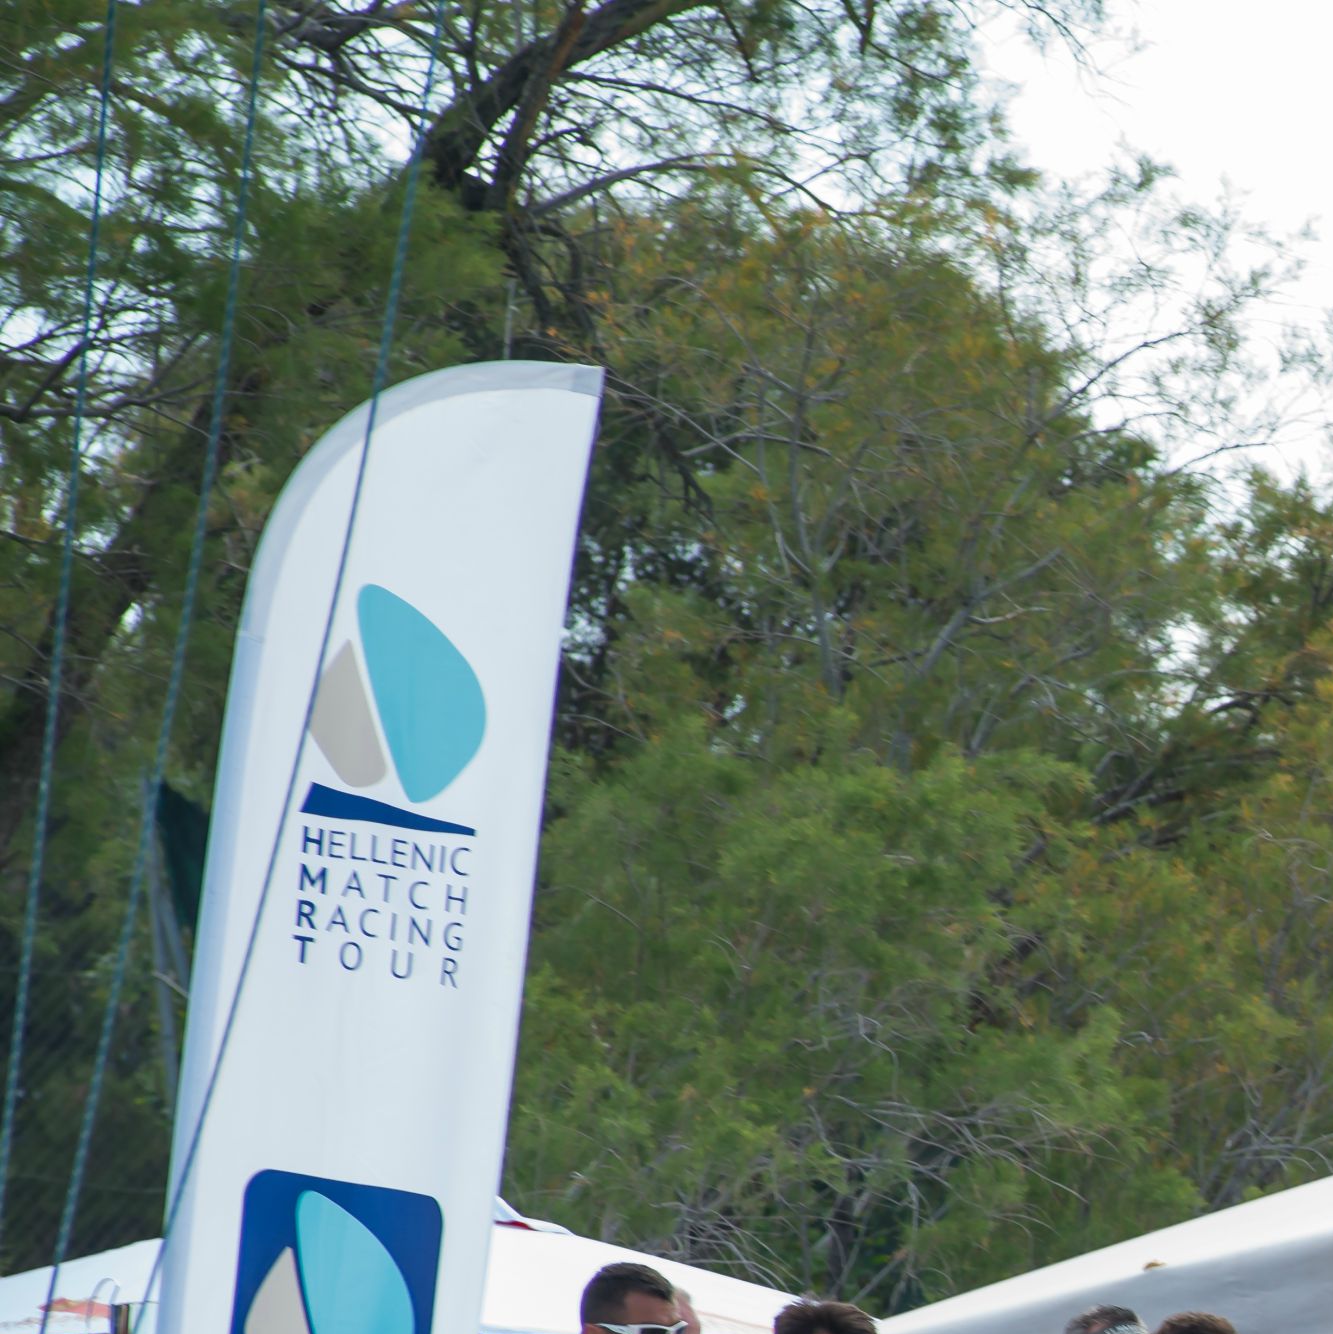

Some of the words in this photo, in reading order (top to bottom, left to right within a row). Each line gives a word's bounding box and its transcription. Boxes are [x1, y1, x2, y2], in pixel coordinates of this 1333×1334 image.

[302, 825, 471, 876] HELLENIC
[298, 863, 468, 915] MATCH
[296, 899, 464, 952] RACING
[292, 934, 458, 989] TOUR
